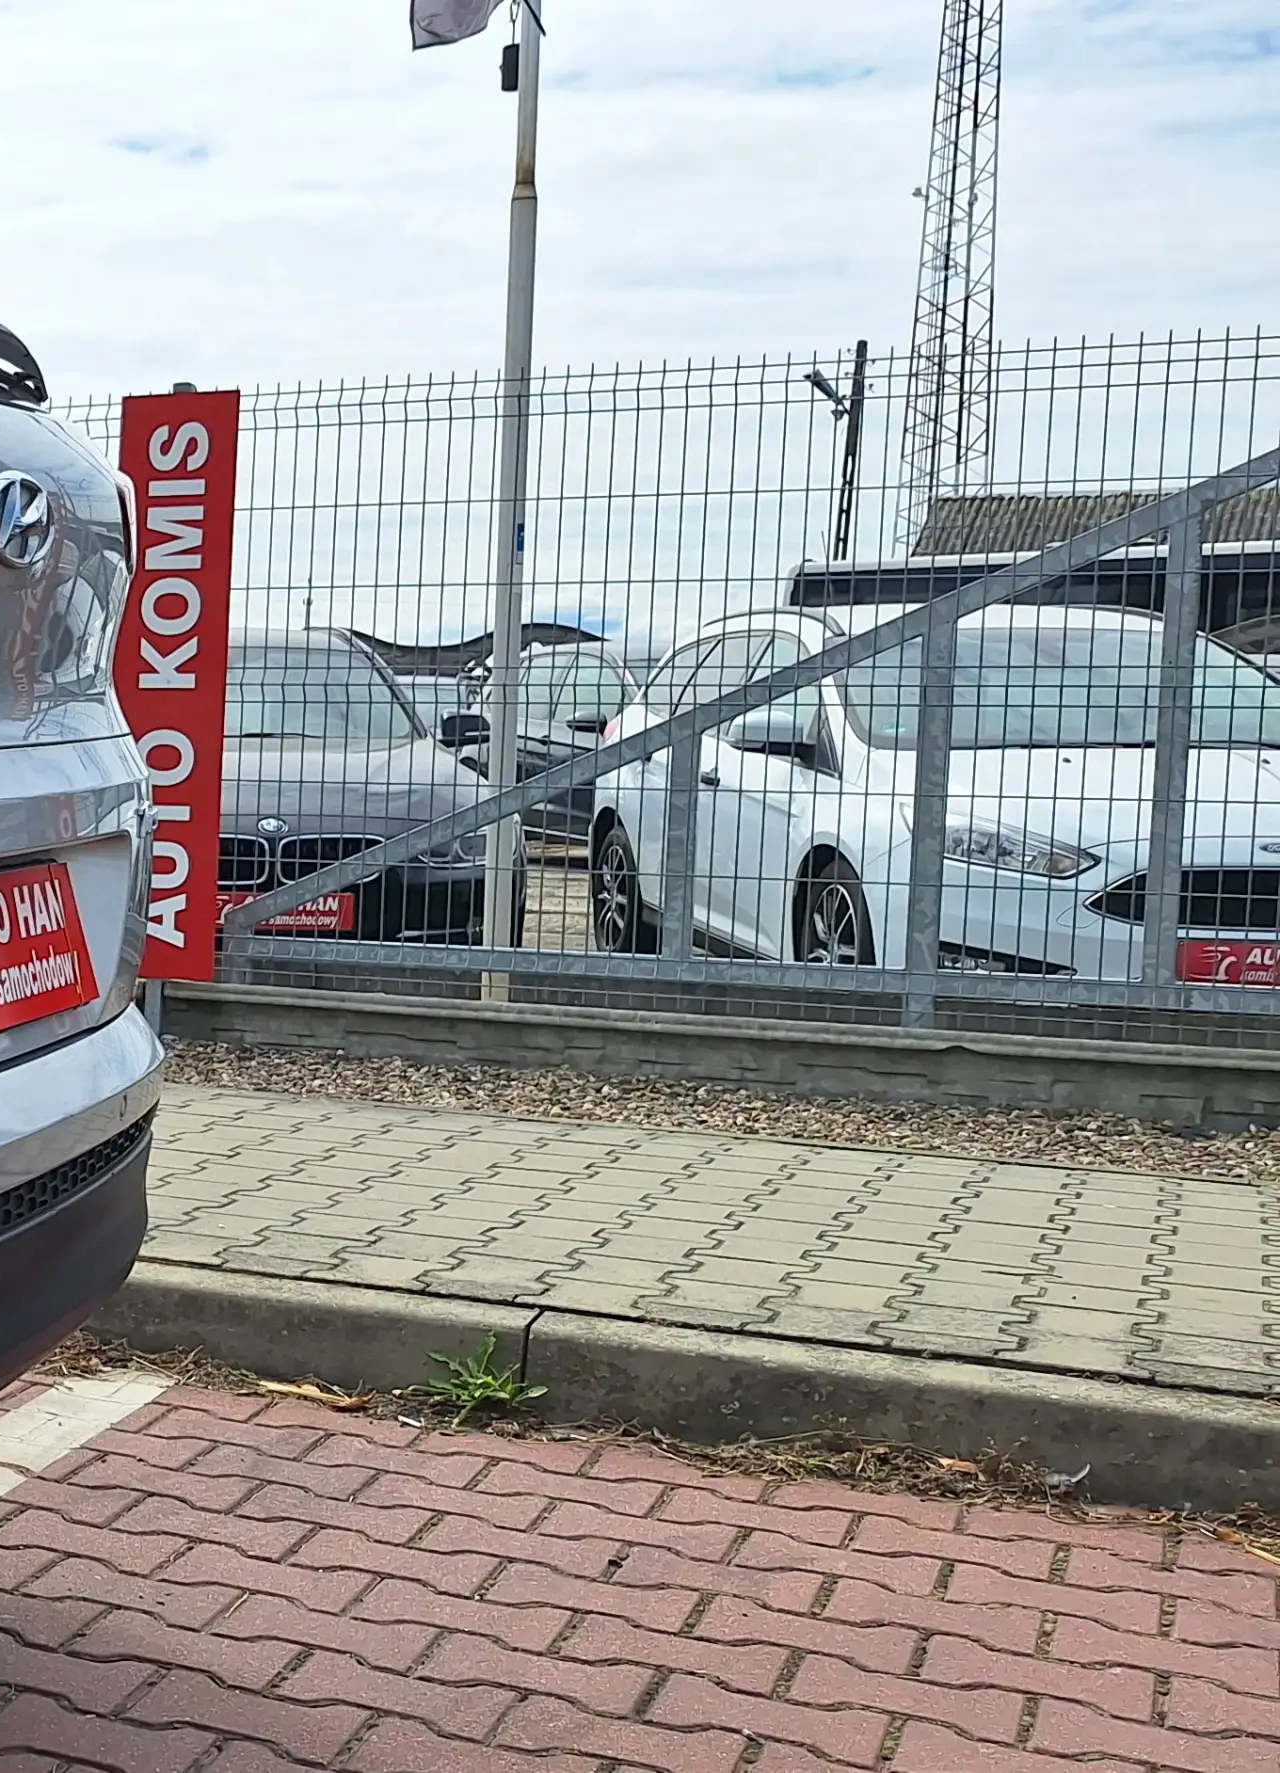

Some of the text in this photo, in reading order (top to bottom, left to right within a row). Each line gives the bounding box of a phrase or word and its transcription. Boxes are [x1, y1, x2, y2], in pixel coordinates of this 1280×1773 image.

[135, 420, 210, 949] AUTO KOMIS
[12, 879, 65, 939] HAN
